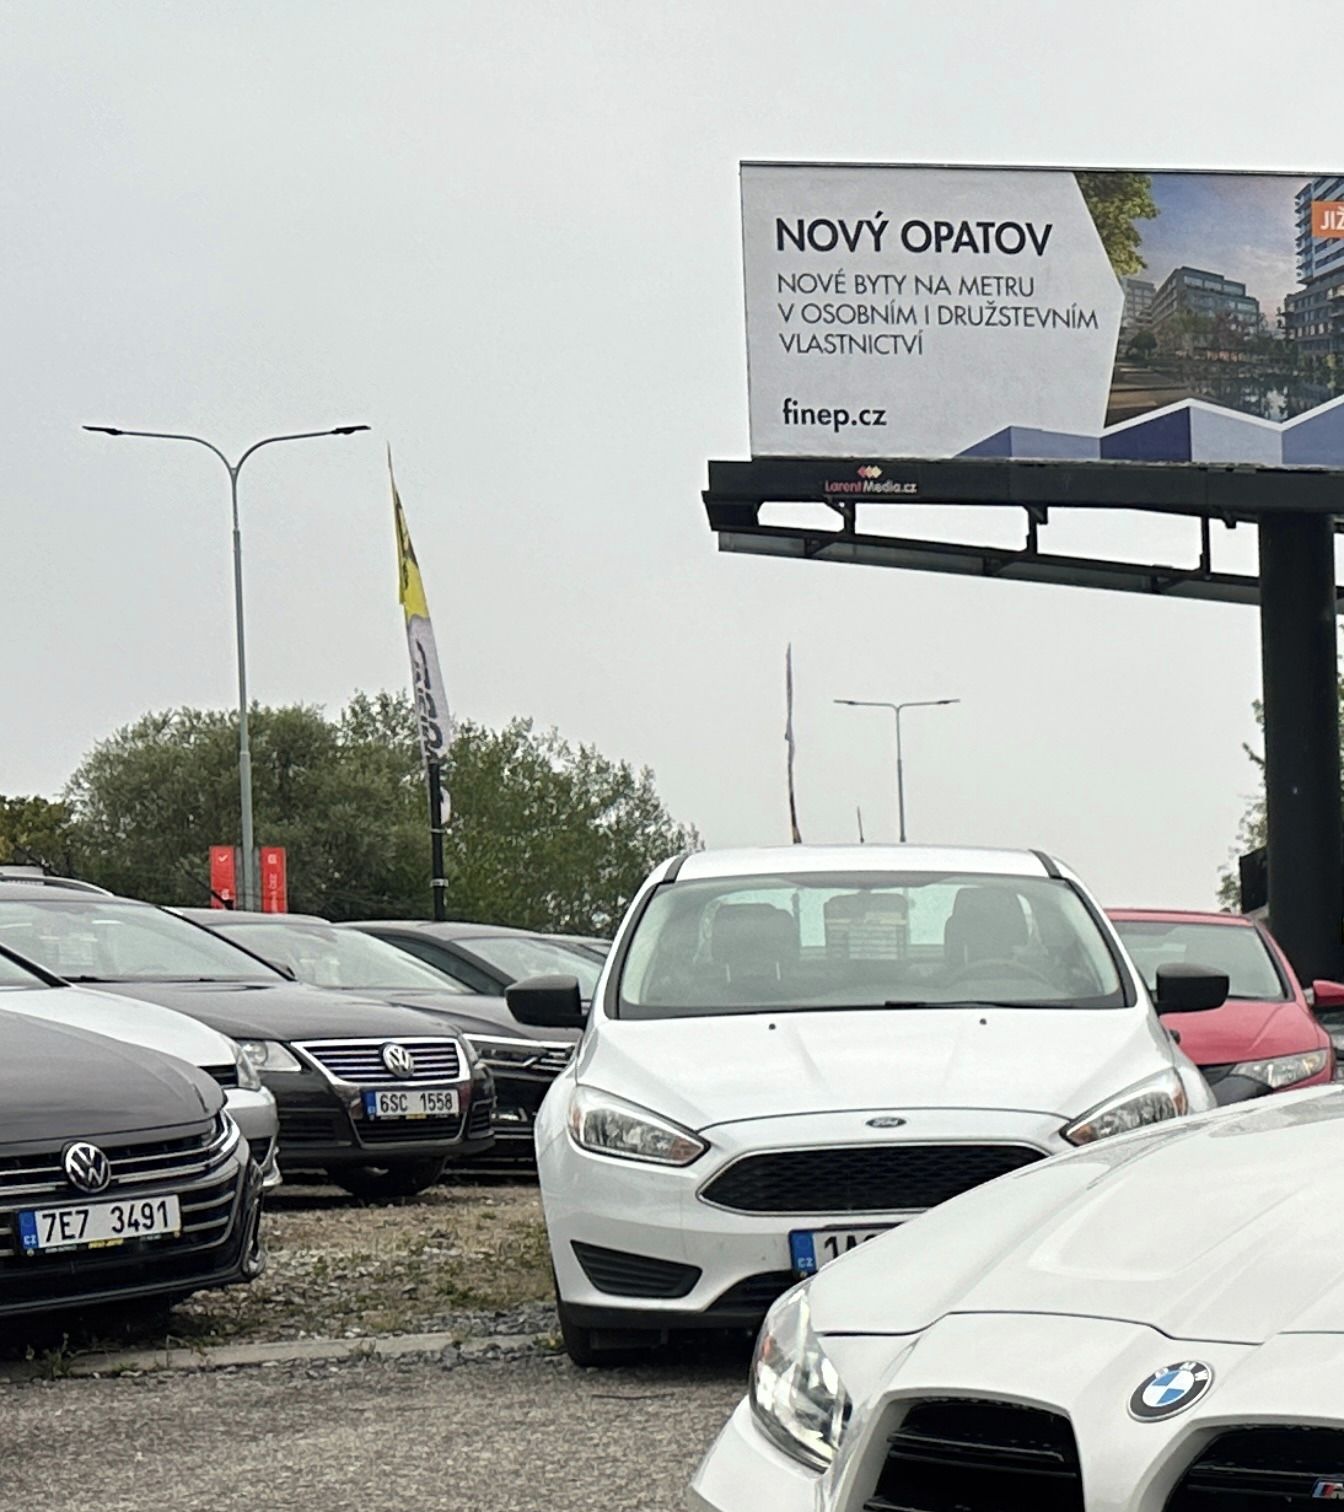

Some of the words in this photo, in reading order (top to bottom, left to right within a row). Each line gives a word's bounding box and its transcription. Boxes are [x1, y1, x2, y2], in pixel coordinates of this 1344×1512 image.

[776, 211, 889, 252] NOVÝ
[901, 219, 1053, 256] OPATOV
[778, 268, 847, 294] NOVÉ
[855, 274, 907, 295] BYTY
[915, 275, 952, 296] NA
[958, 276, 1034, 297] METRU
[778, 303, 794, 323] V
[801, 299, 917, 325] OSOBNÍM
[925, 304, 929, 325] I
[938, 300, 1099, 330] DRUŽSTEVNÍM
[779, 330, 923, 355] VLASTNICTVÍ
[783, 398, 887, 432] finep.cz
[381, 1094, 408, 1113] 6SC
[420, 1092, 452, 1112] 1558
[42, 1209, 89, 1243] 7E7
[111, 1201, 168, 1233] 3491
[798, 1258, 813, 1267] CZ
